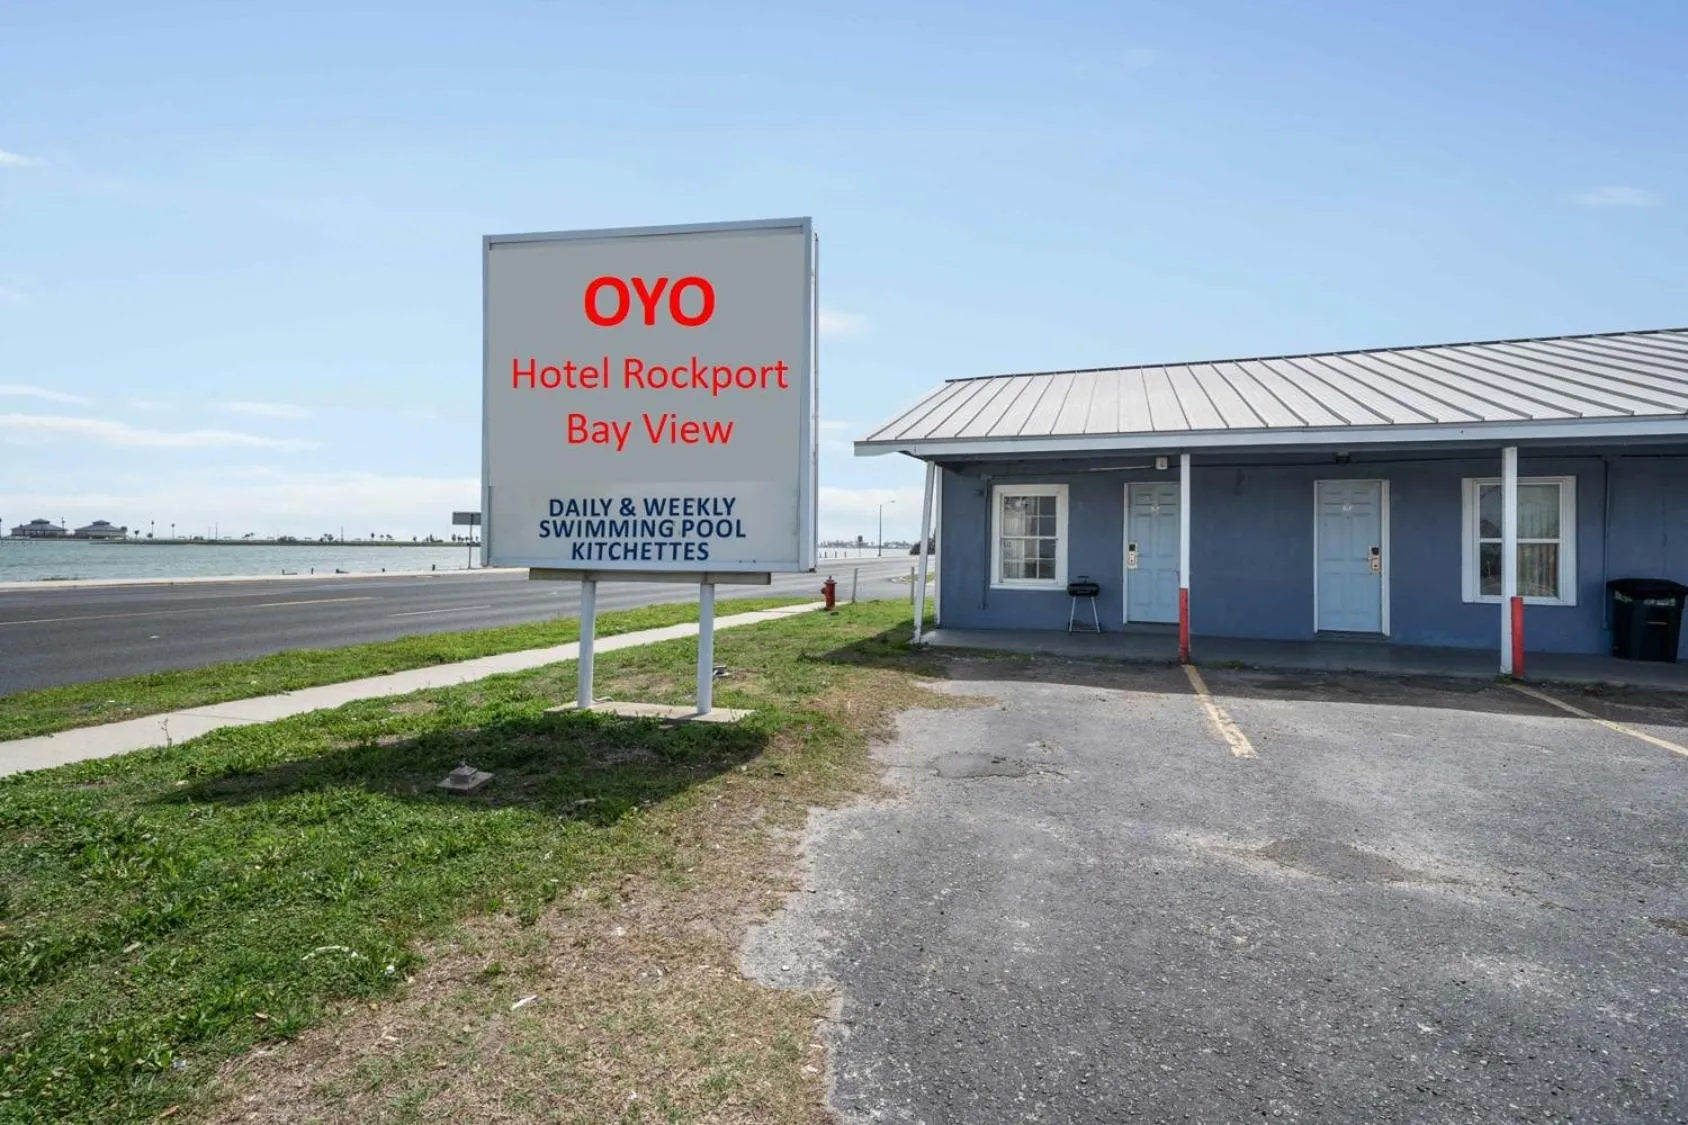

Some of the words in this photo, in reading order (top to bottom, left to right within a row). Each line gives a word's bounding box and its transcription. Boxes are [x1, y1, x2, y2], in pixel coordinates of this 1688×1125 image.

[583, 275, 716, 328] OYO
[512, 356, 610, 390] Hotel
[623, 356, 788, 397] Rockport
[567, 412, 632, 452] Bay
[642, 413, 734, 445] View
[550, 498, 612, 517] DAILY
[619, 498, 636, 516] &
[643, 497, 735, 516] WEEKLY
[539, 519, 674, 538] SWIMMING
[682, 519, 746, 538] POOL
[572, 542, 709, 561] KITCHETTES
